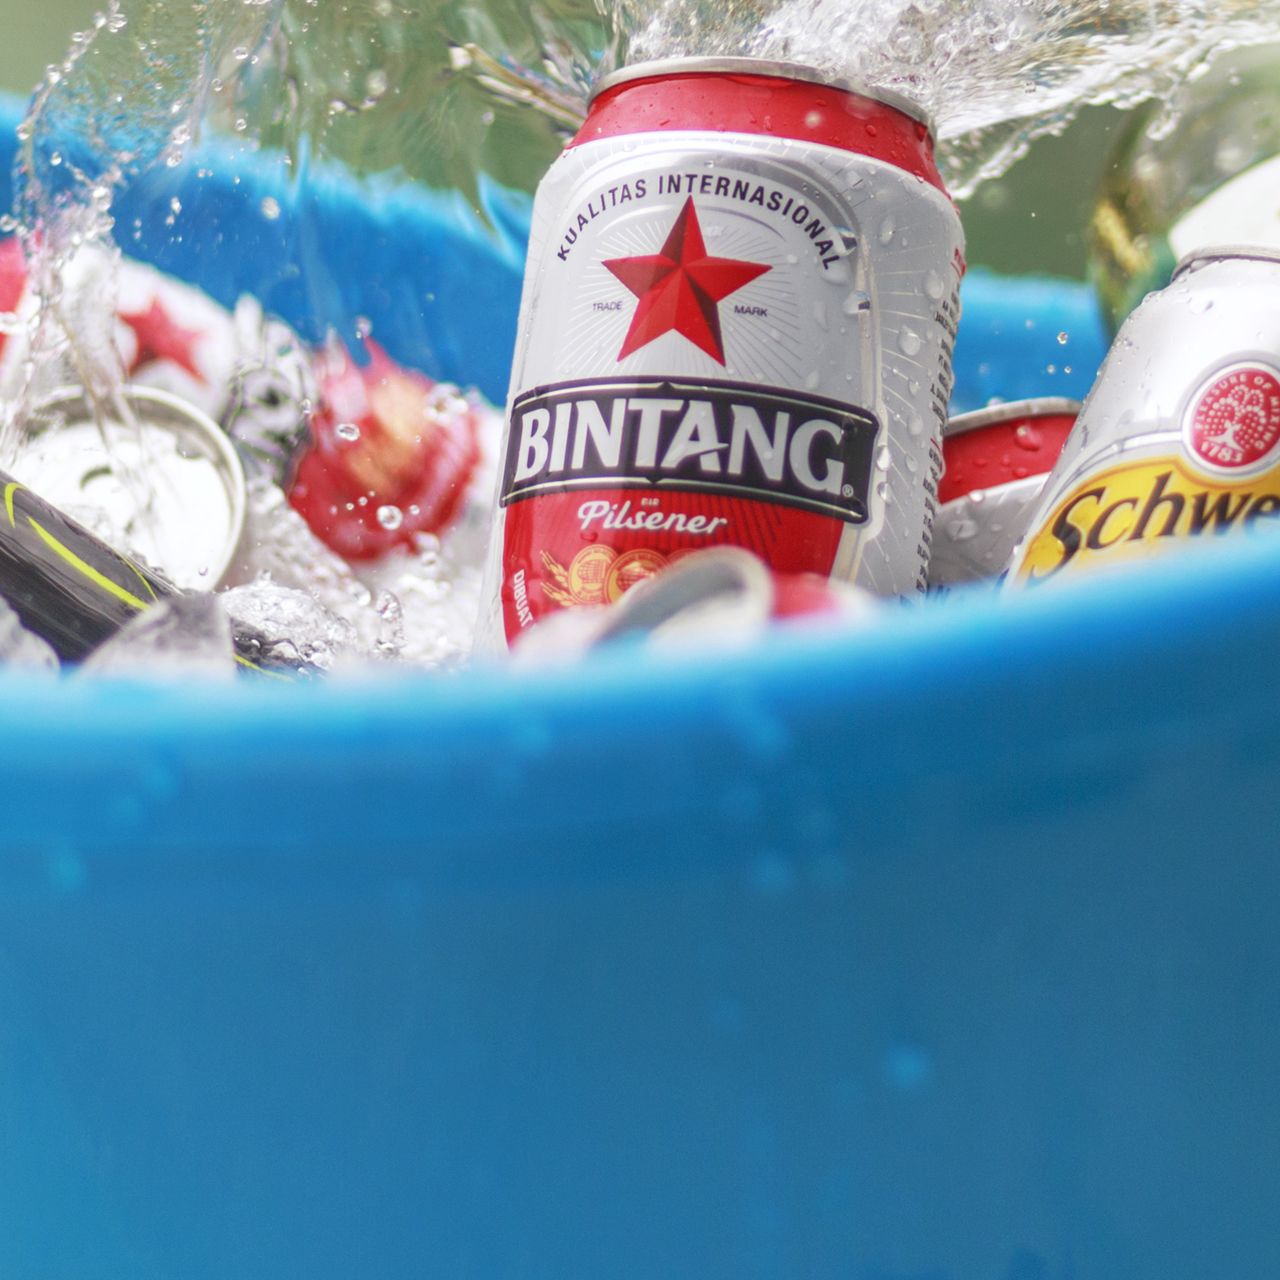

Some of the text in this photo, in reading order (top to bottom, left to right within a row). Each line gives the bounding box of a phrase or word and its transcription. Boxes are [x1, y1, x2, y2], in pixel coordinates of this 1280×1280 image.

[556, 173, 841, 271] KUALITAS INTERNASIONAL
[592, 301, 768, 318] TRADE MARK
[1194, 373, 1280, 450] PLEASURE OF MIXING
[513, 397, 845, 496] BINTANG
[1200, 441, 1244, 463] 1783
[577, 499, 729, 535] Pilsener
[640, 497, 661, 507] BIR
[513, 568, 534, 628] DIBUAT
